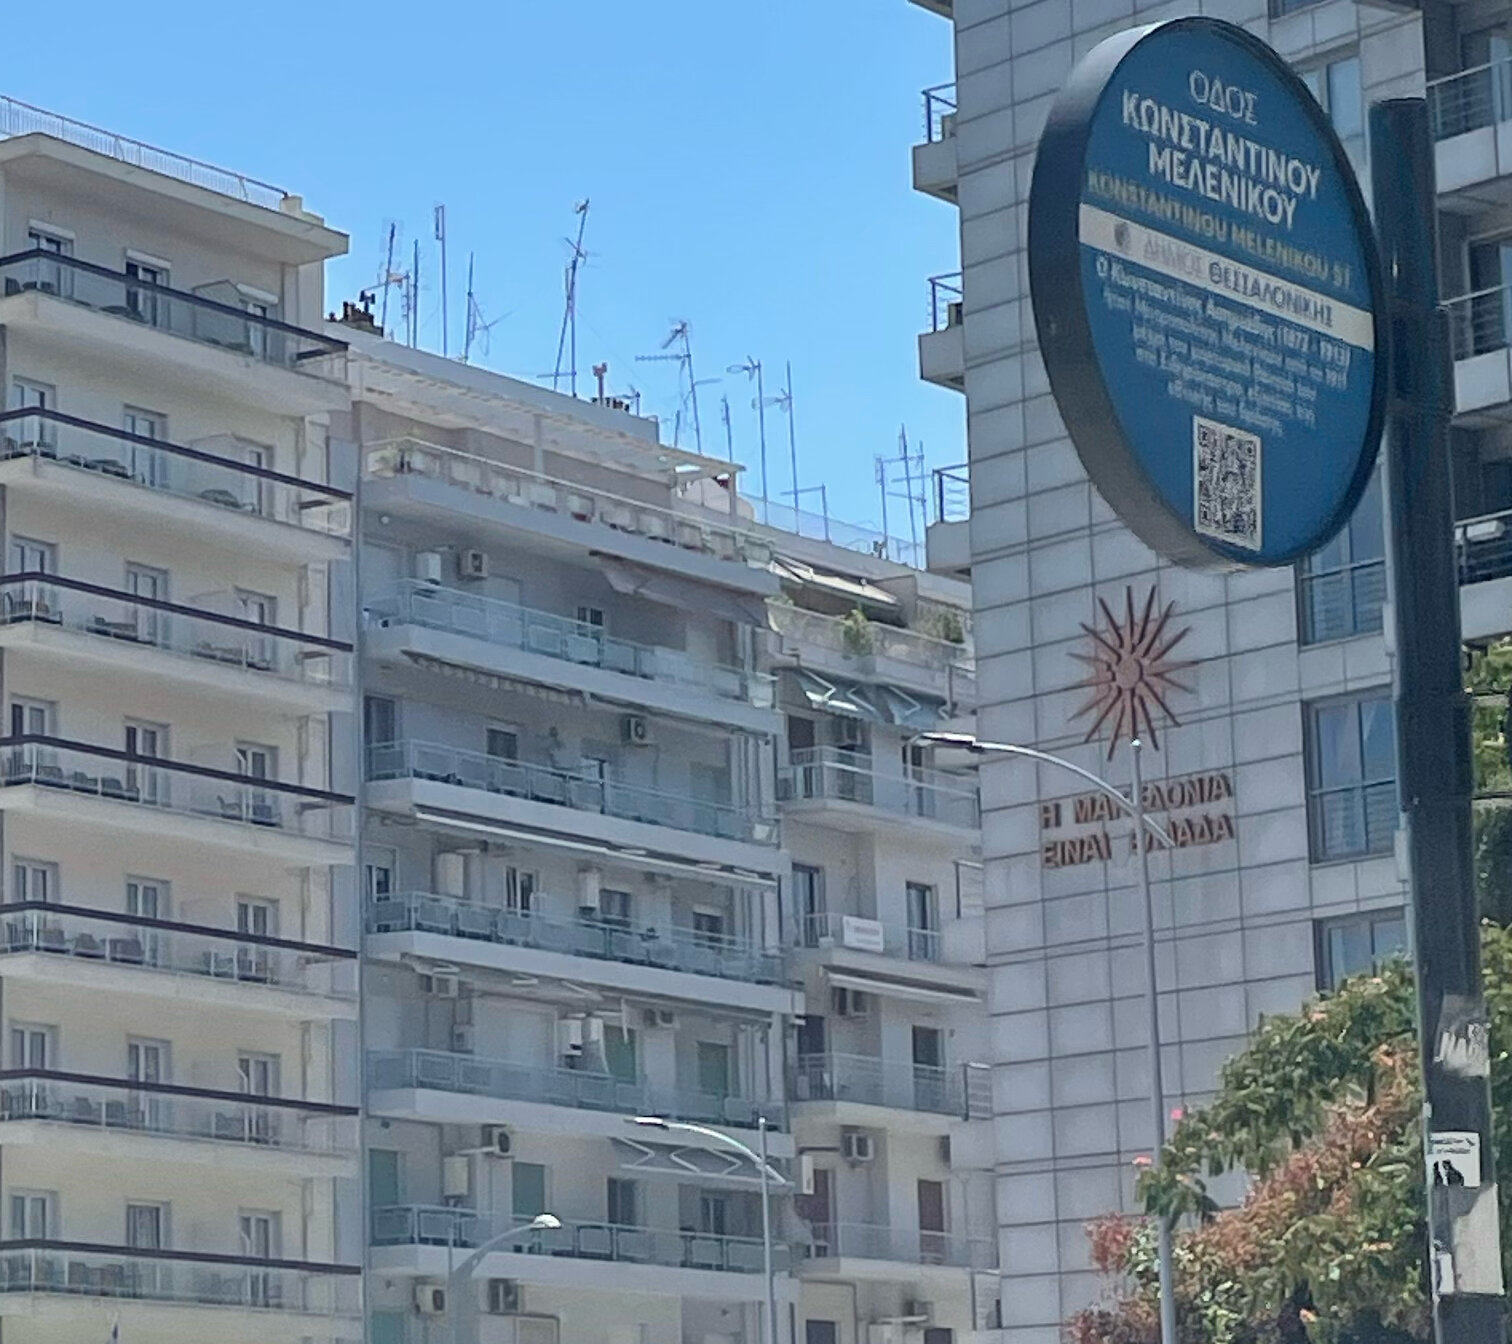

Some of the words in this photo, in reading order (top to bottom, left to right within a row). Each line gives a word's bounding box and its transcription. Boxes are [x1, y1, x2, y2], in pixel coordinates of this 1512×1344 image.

[1189, 70, 1259, 126] ΟΔΟΣ
[1122, 89, 1321, 200] ΚΩΝΣΤΑΝΤΙΝΟΥ
[1149, 142, 1298, 230] ΜΕΛΕΝΙΚΟΥ
[1088, 169, 1227, 243] KONSTANTINOU
[1231, 222, 1329, 281] MELENIKOU
[1209, 261, 1334, 328] ΘΕΣΣΑΛΟΝΙΚΗΣ
[1041, 803, 1062, 830] Η
[1044, 832, 1113, 870] ΕΙΝΑΙ
